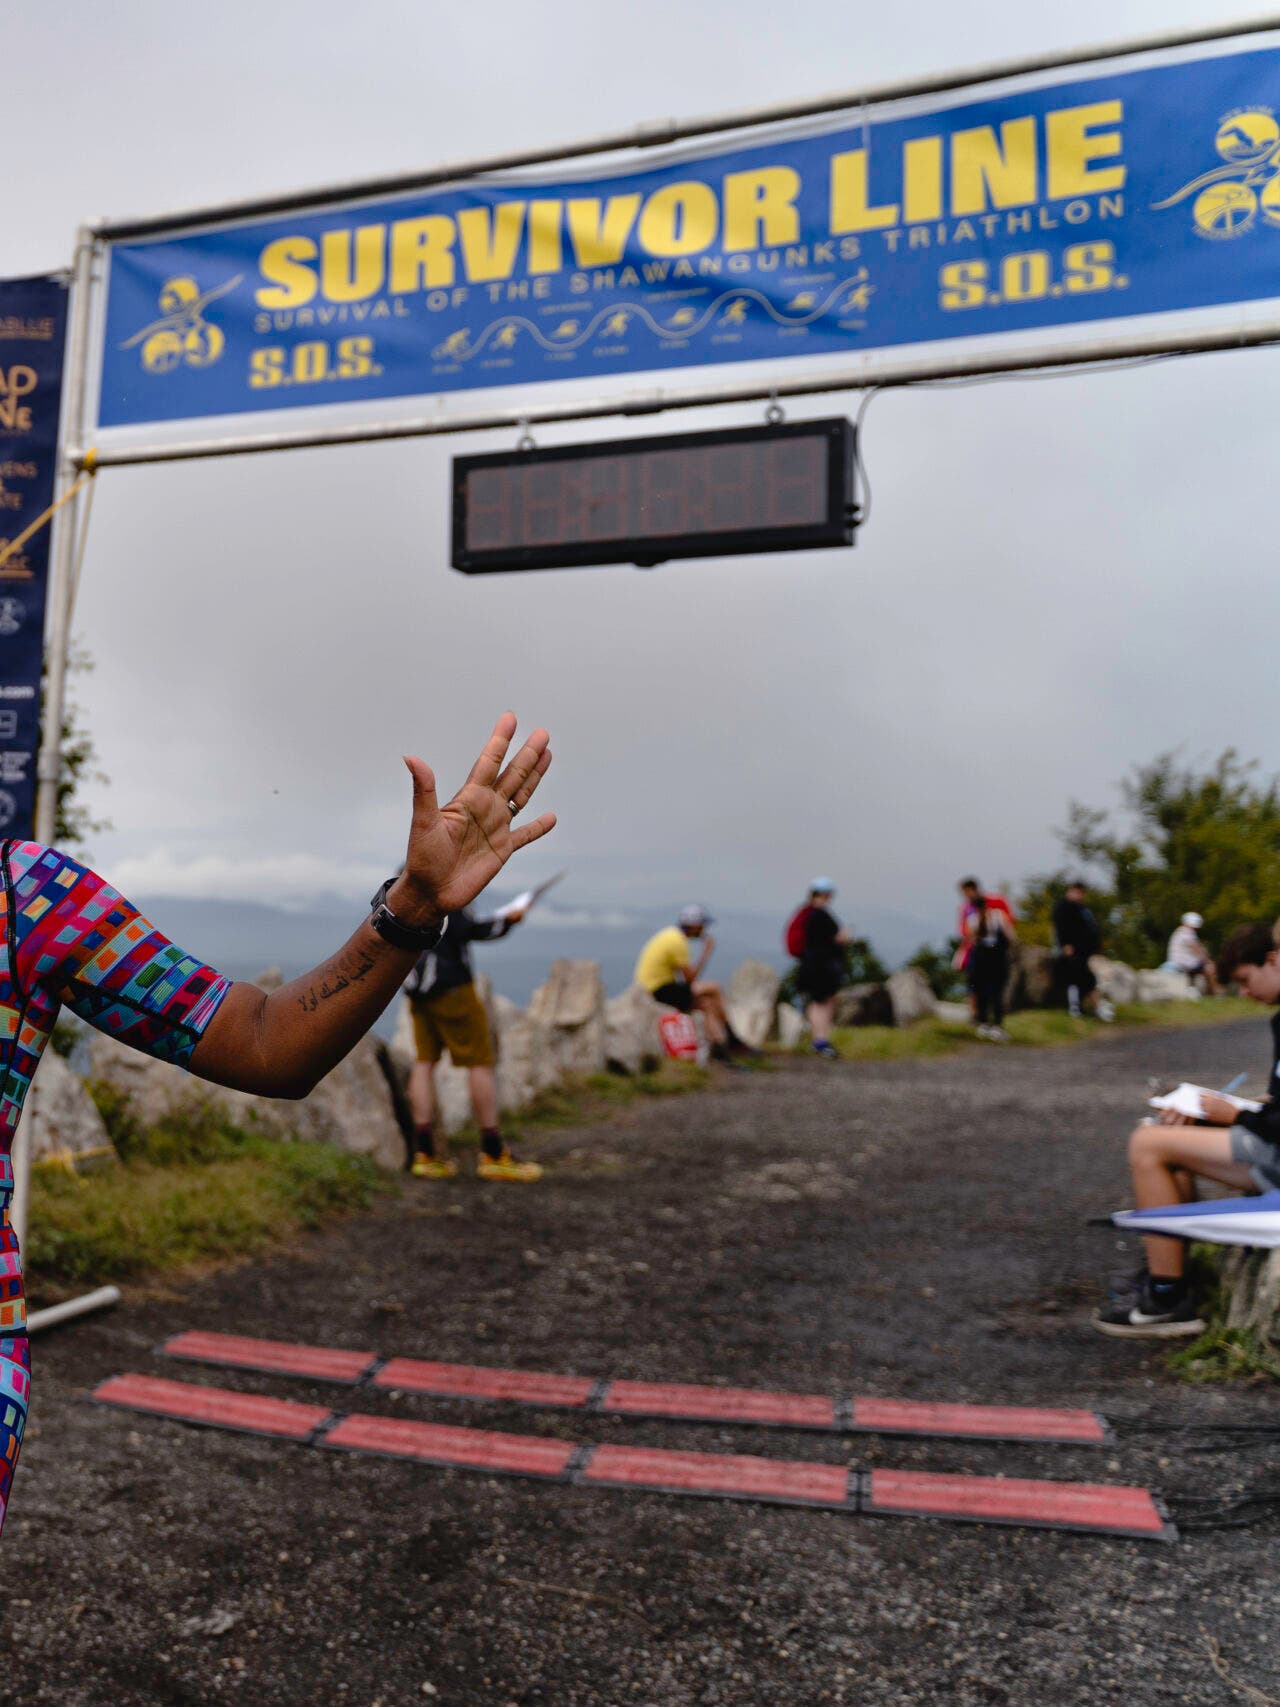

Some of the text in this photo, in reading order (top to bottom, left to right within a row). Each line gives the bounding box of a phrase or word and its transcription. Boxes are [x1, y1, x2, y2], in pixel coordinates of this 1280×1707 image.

[254, 98, 1127, 310] SURVIVOR LINE
[255, 194, 1124, 335] SURVIVAL OF THE SHAWANGUNKS TRIATHLON
[939, 239, 1131, 312] S.O.S.
[248, 335, 384, 390] S.O.S.
